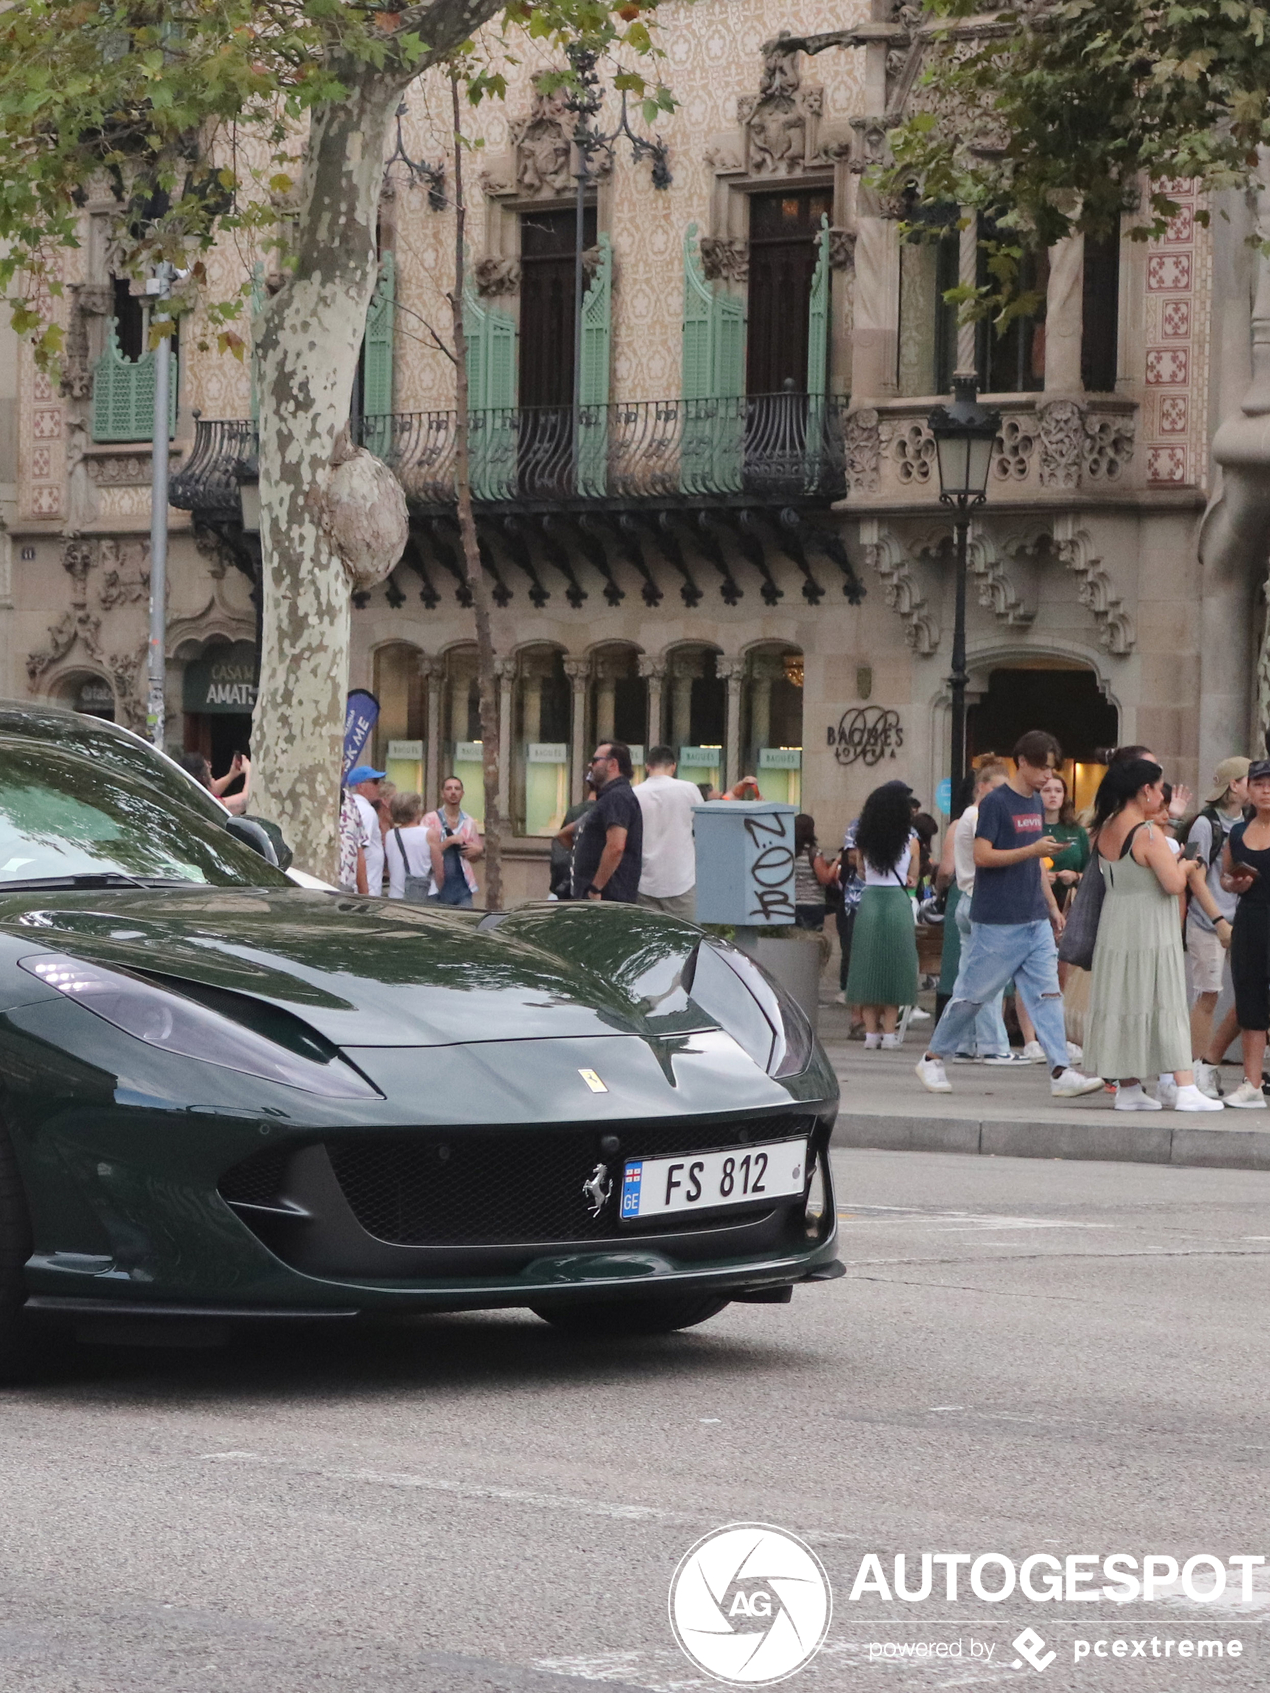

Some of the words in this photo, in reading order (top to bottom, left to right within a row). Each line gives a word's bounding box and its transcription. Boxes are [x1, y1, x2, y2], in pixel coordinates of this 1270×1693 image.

[352, 716, 370, 746] ME
[665, 1161, 704, 1206] FS
[720, 1153, 768, 1197] 812
[623, 1193, 639, 1210] GE
